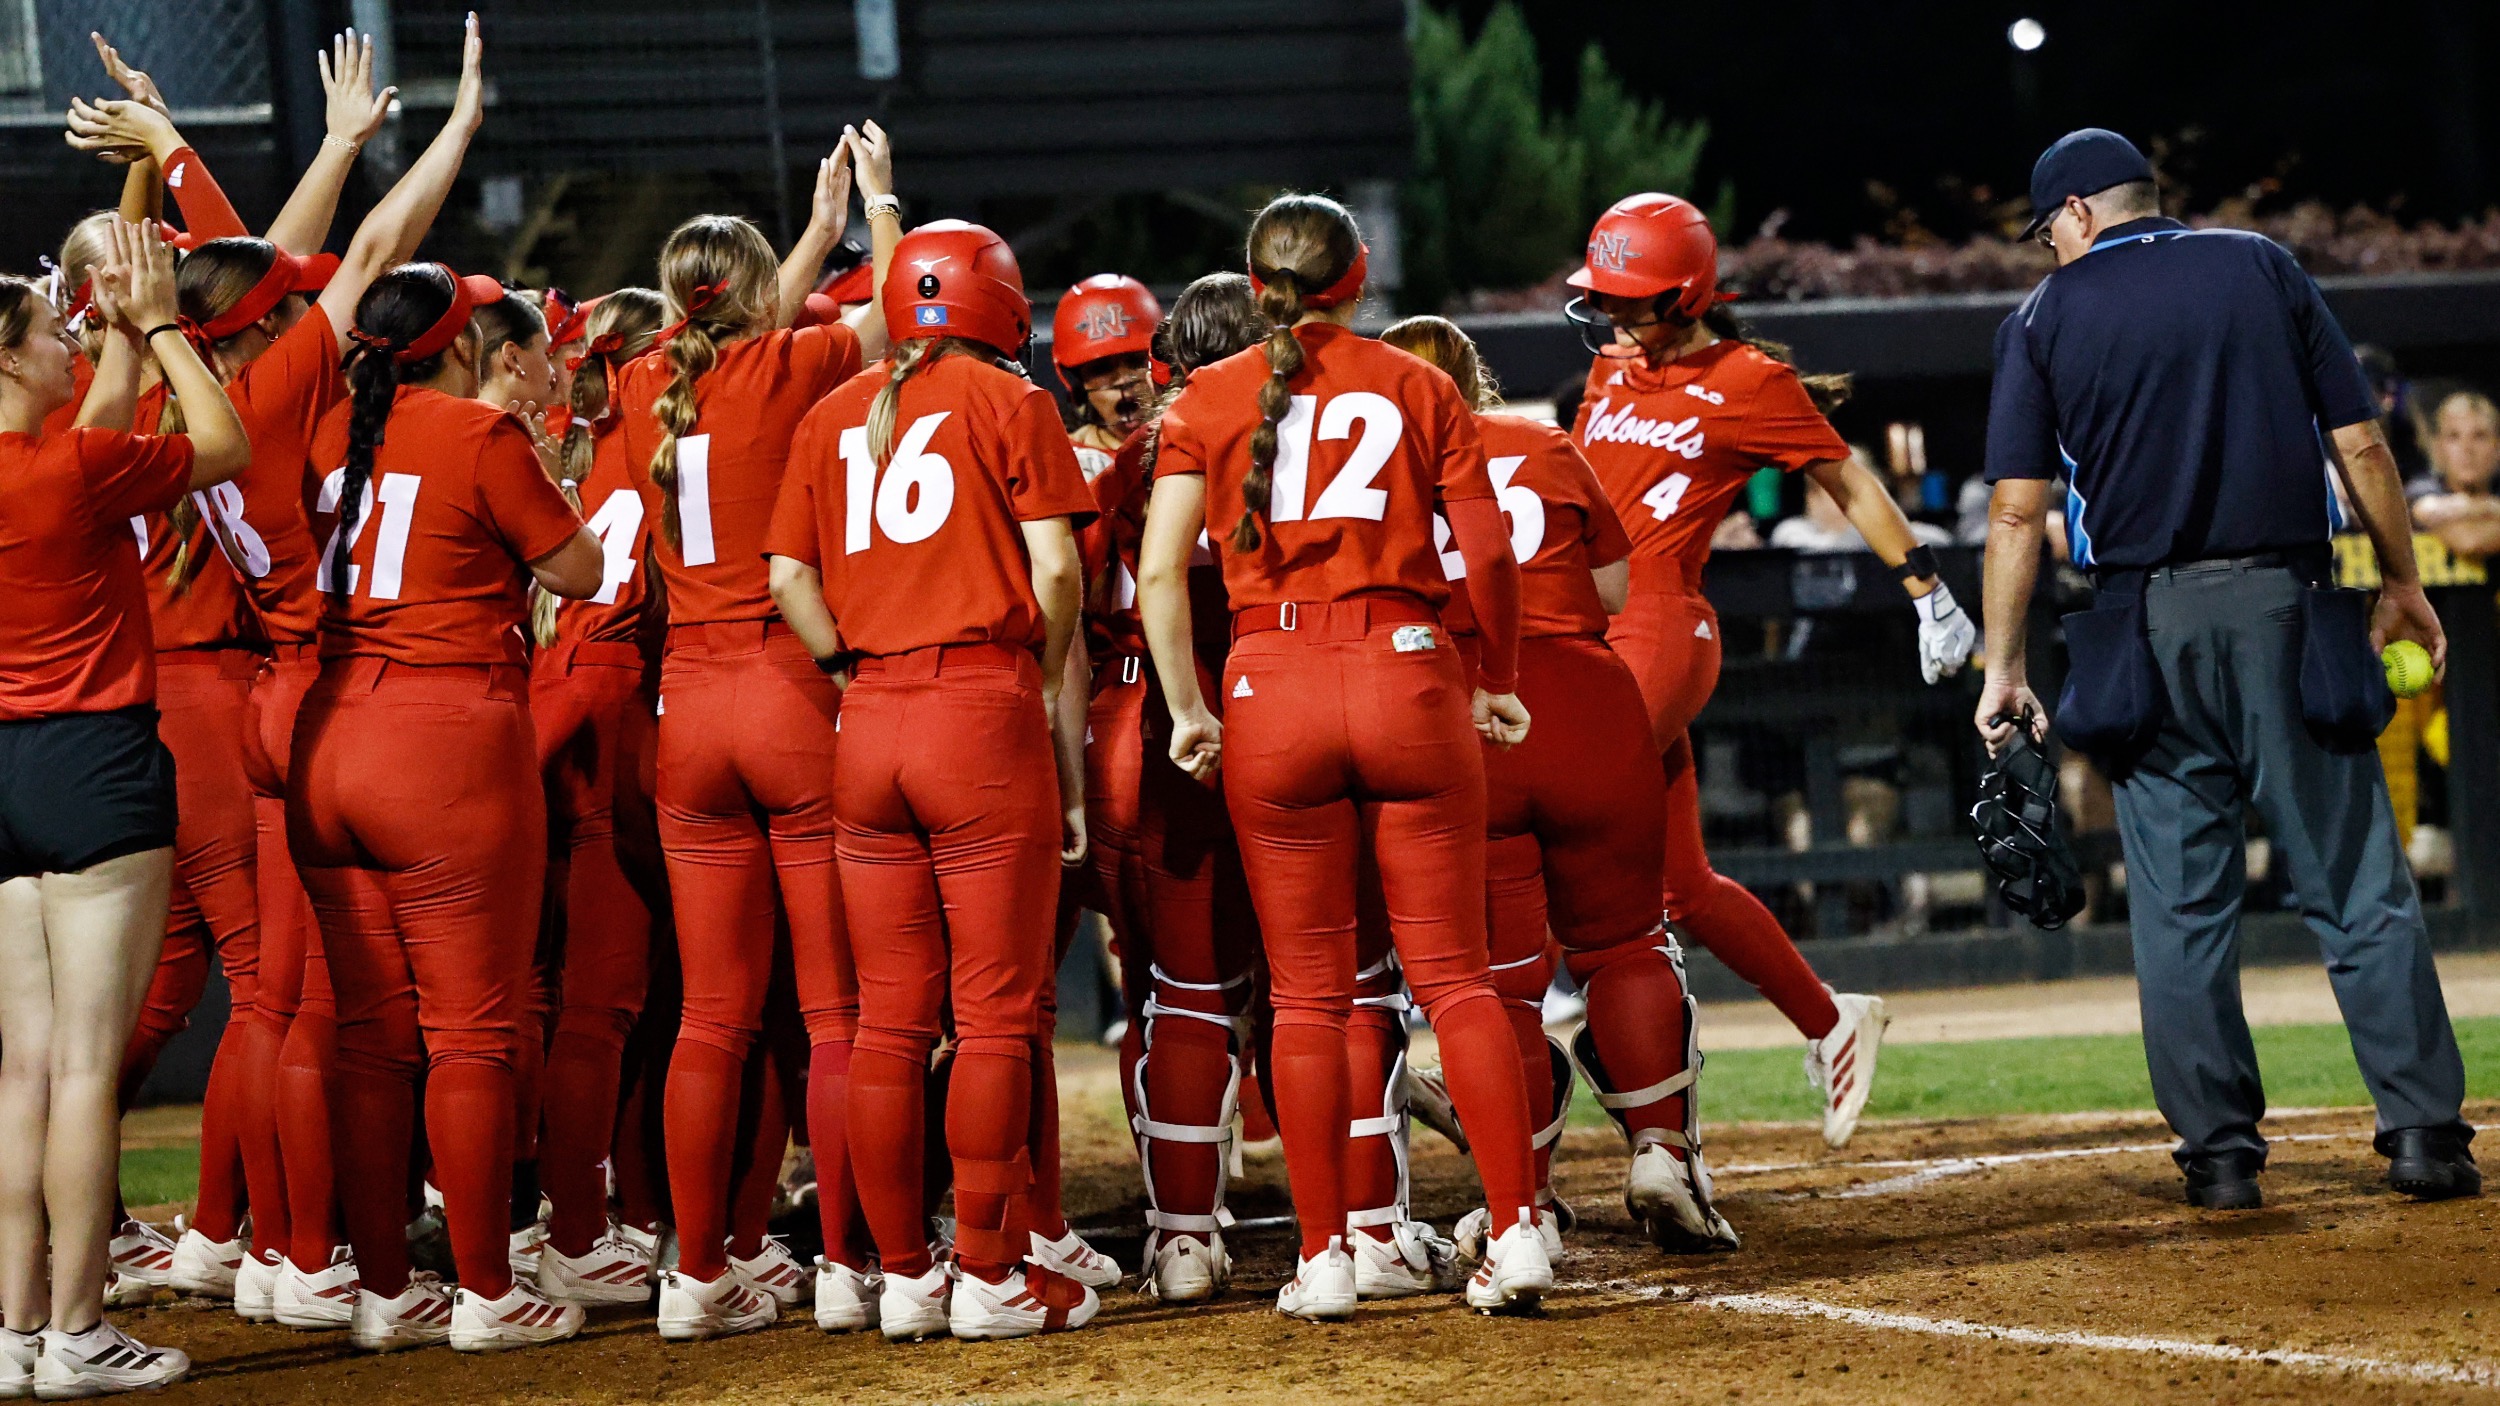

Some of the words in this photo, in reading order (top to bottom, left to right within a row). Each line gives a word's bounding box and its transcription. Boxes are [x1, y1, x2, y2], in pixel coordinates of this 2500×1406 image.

[1593, 230, 1630, 272] N
[1085, 303, 1128, 341] N
[838, 411, 955, 556] 16
[1270, 391, 1404, 523] 12
[1642, 471, 1692, 522] 4
[316, 466, 422, 600] 21
[556, 488, 645, 608] 4
